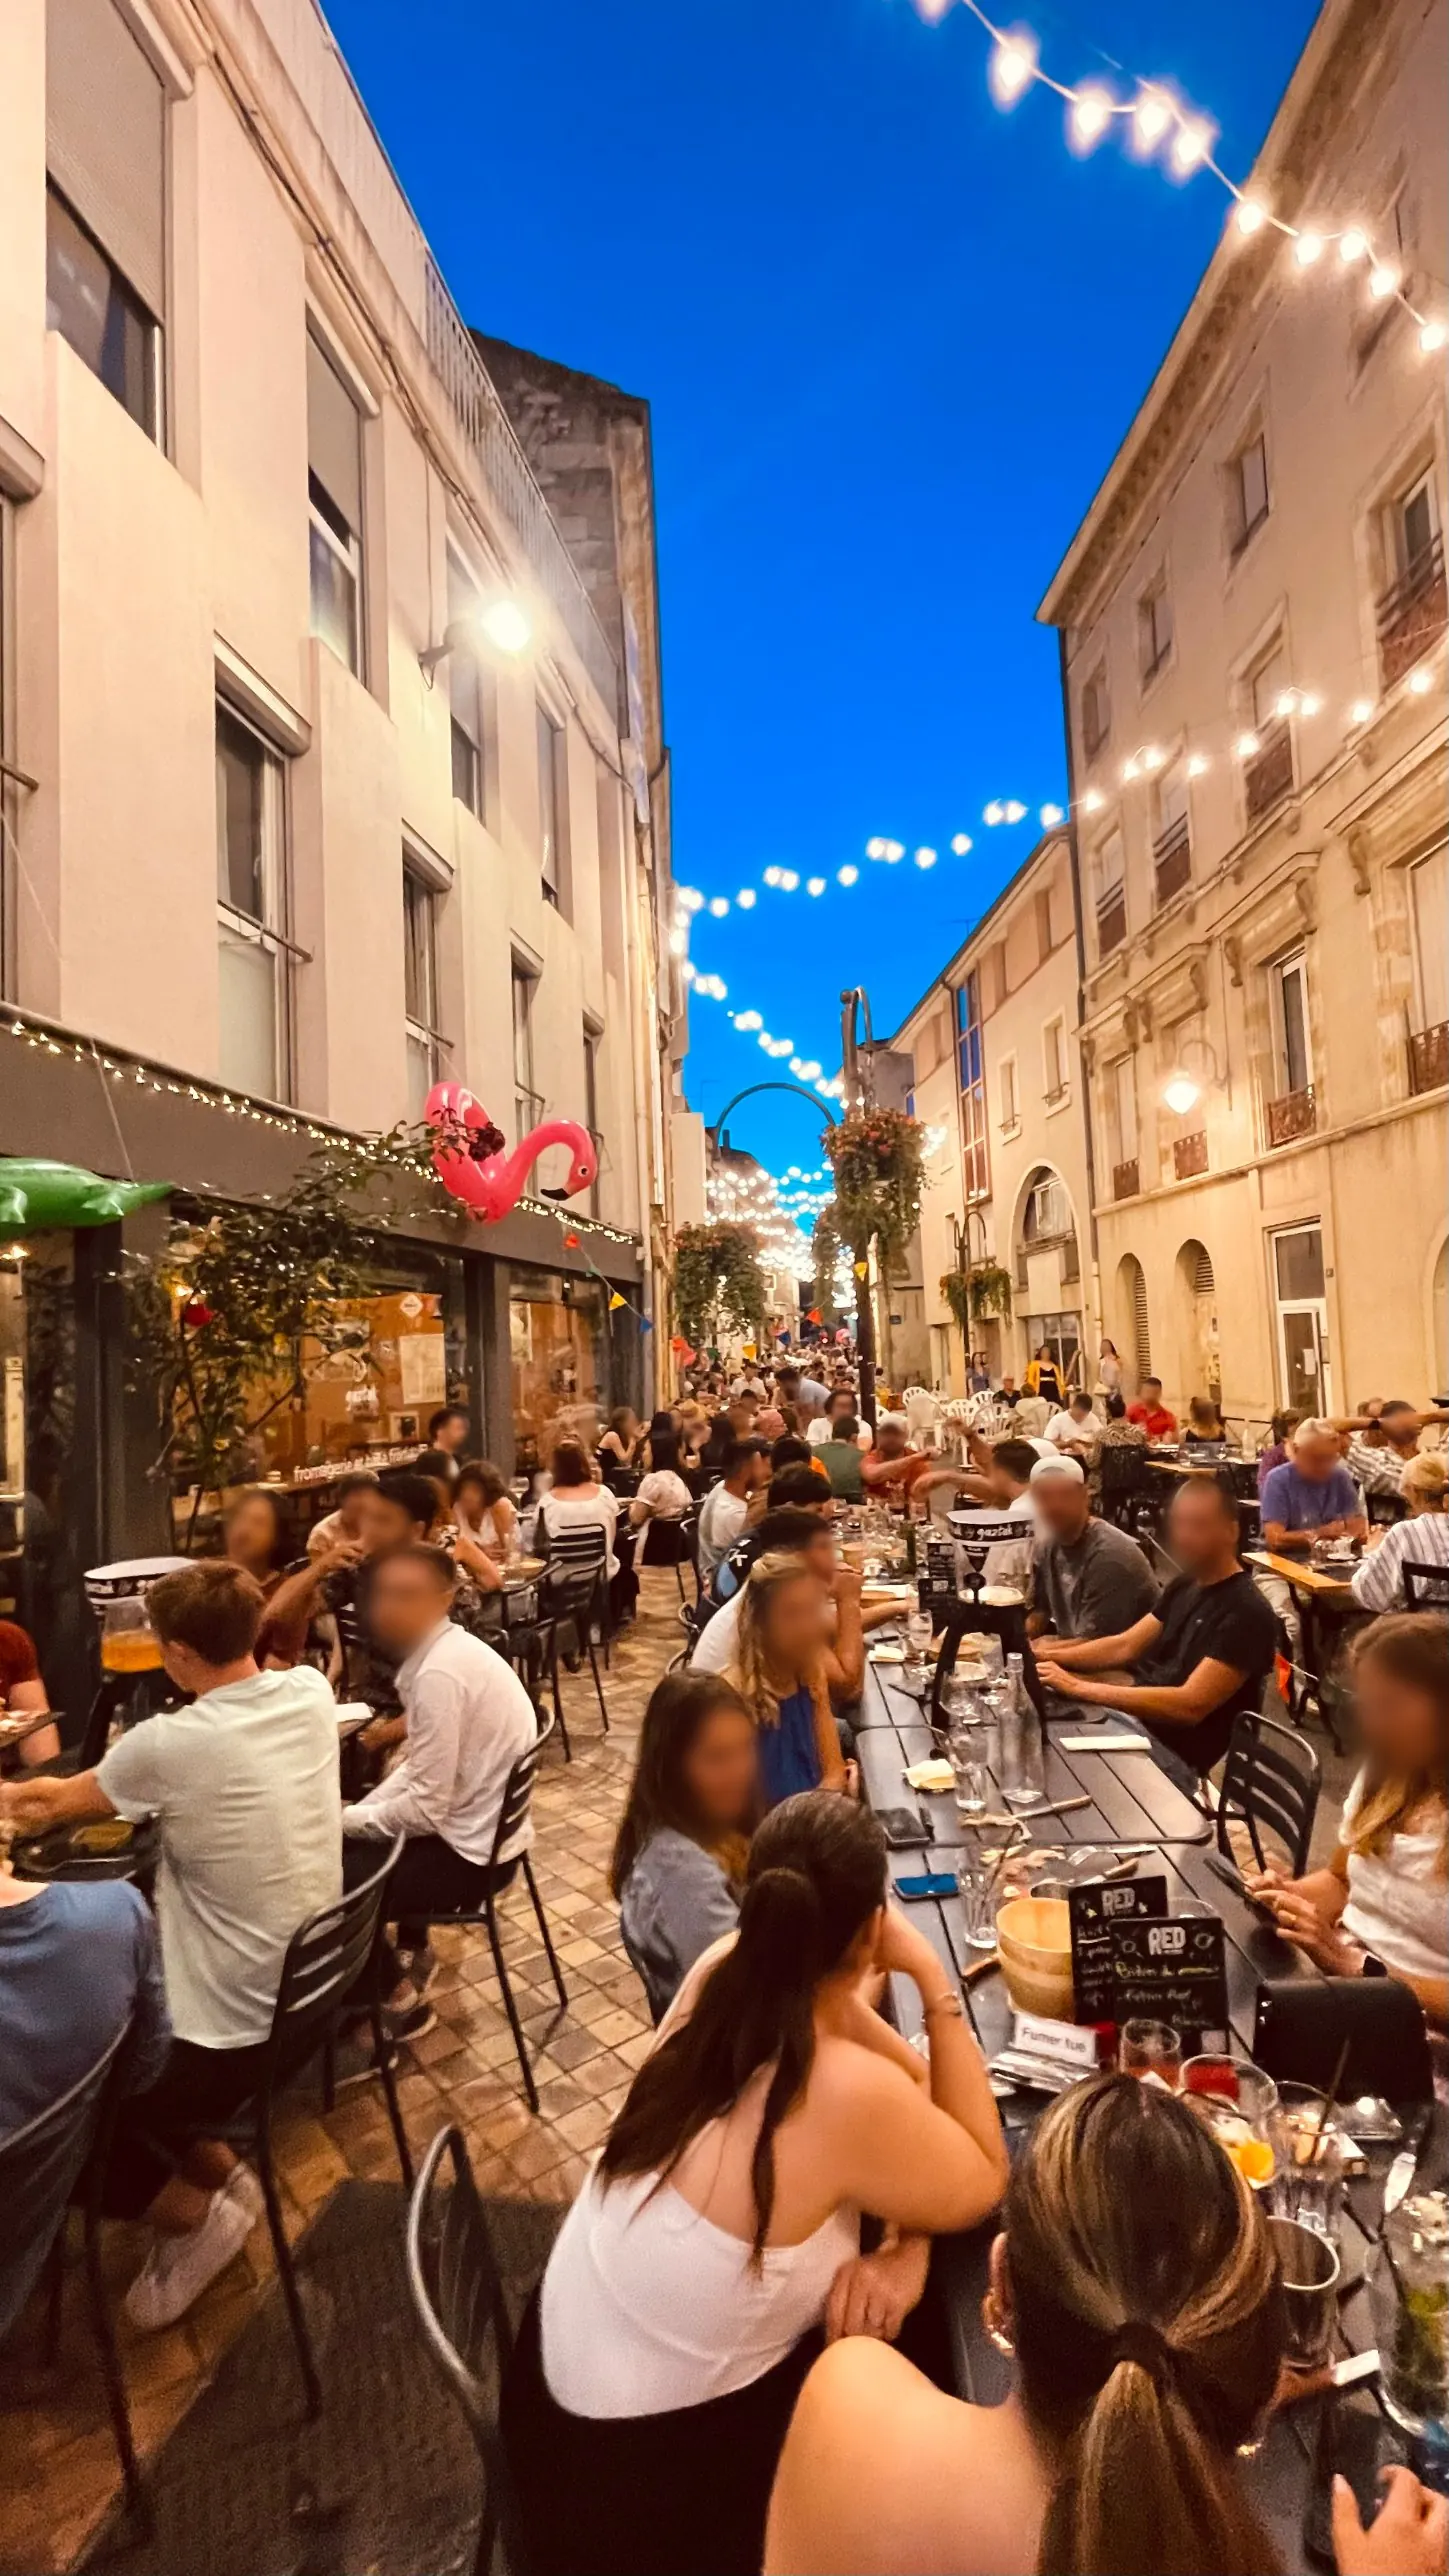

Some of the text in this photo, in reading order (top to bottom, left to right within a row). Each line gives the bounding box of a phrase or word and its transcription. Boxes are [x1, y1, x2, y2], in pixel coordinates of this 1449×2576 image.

[1101, 1887, 1135, 1916] RED
[1148, 1926, 1186, 1956] RED
[1022, 2026, 1087, 2053] Fumer tue
